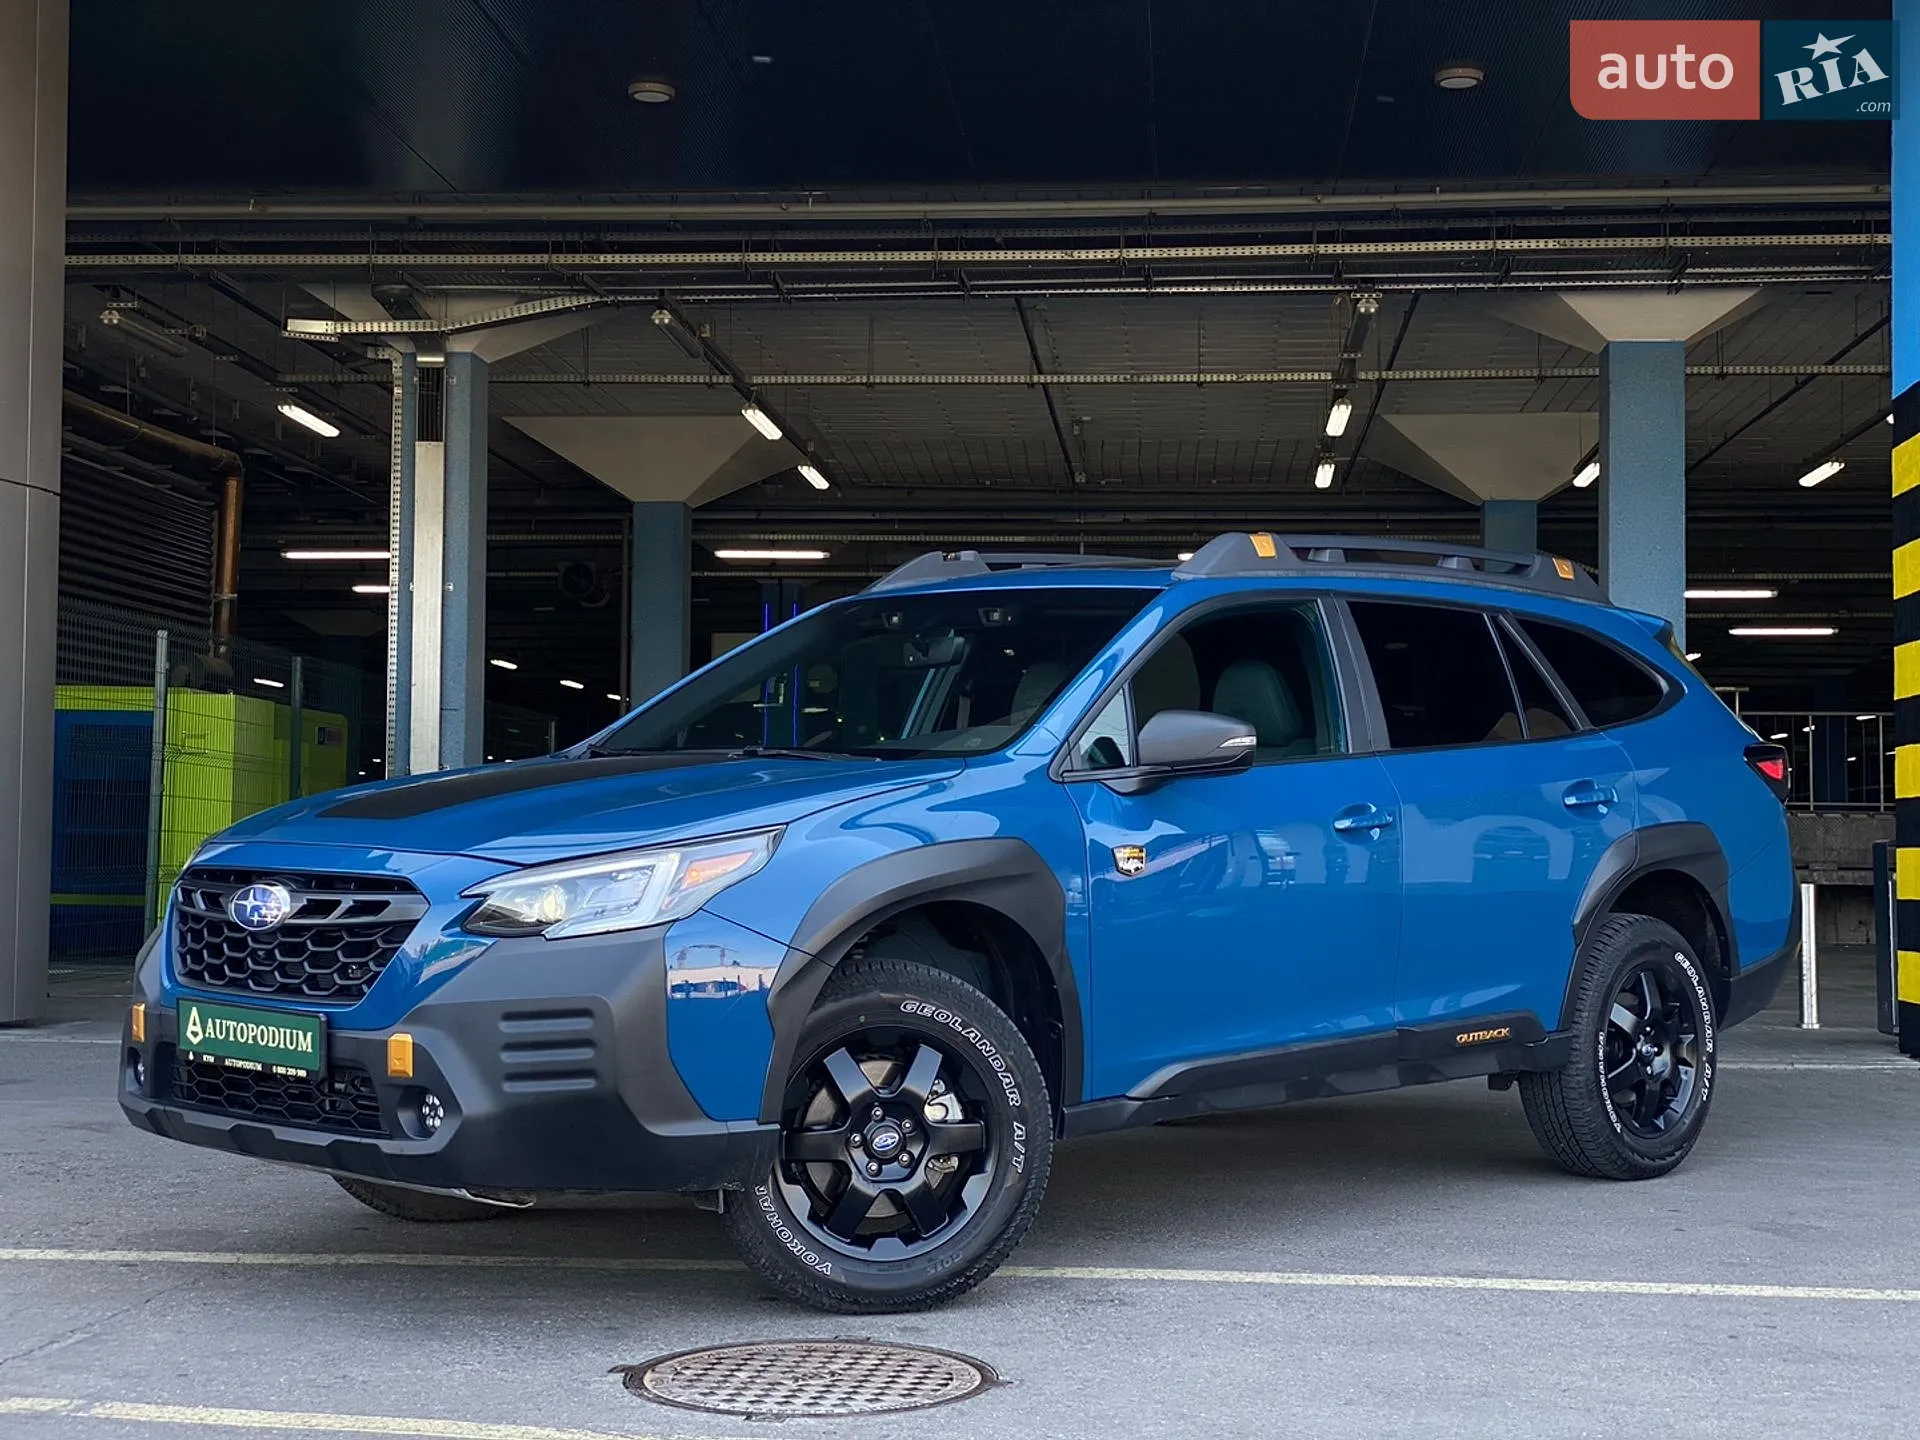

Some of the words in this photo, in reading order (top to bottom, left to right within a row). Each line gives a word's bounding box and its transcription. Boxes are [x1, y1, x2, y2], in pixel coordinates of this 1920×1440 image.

[205, 1017, 313, 1053] AUTOPODIUM
[1455, 1027, 1511, 1044] OUTBACK
[900, 1000, 1023, 1107] GEOLANDAR
[1012, 1121, 1027, 1174] A/T
